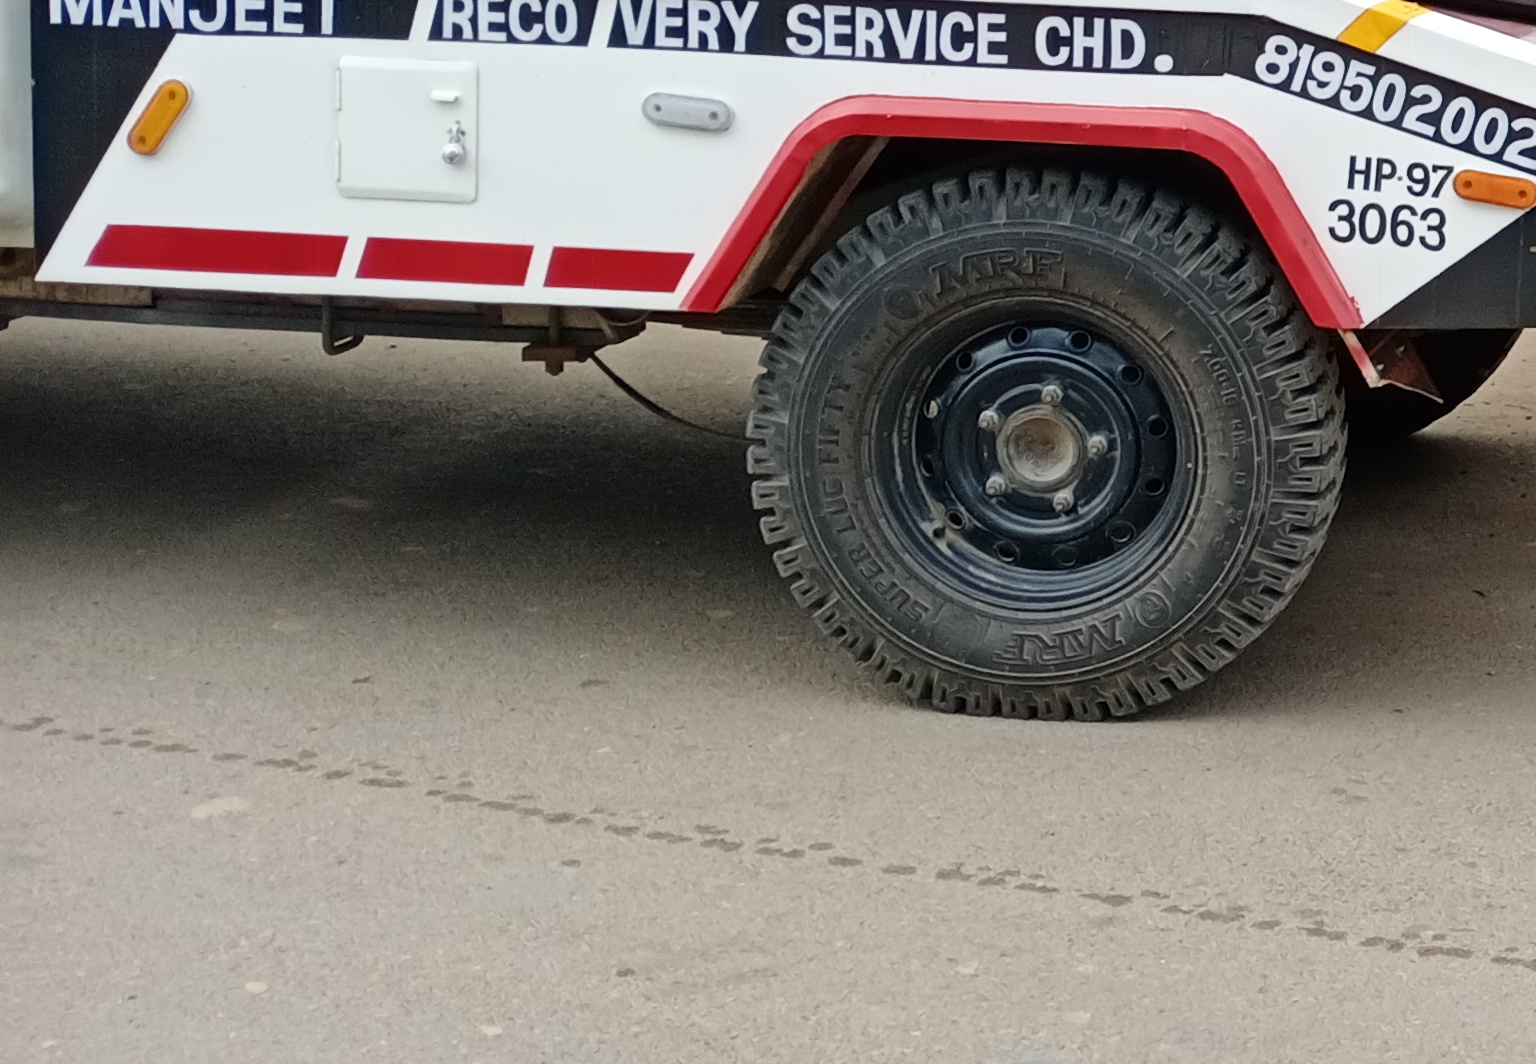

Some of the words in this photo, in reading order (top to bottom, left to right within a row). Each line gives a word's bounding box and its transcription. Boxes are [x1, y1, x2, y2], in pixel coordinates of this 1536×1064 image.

[786, 3, 1009, 64] SERVICE
[1034, 15, 1174, 73] CHD.
[1328, 199, 1446, 252] 3063
[929, 247, 1063, 294] MRF
[992, 612, 1127, 665] MRF
